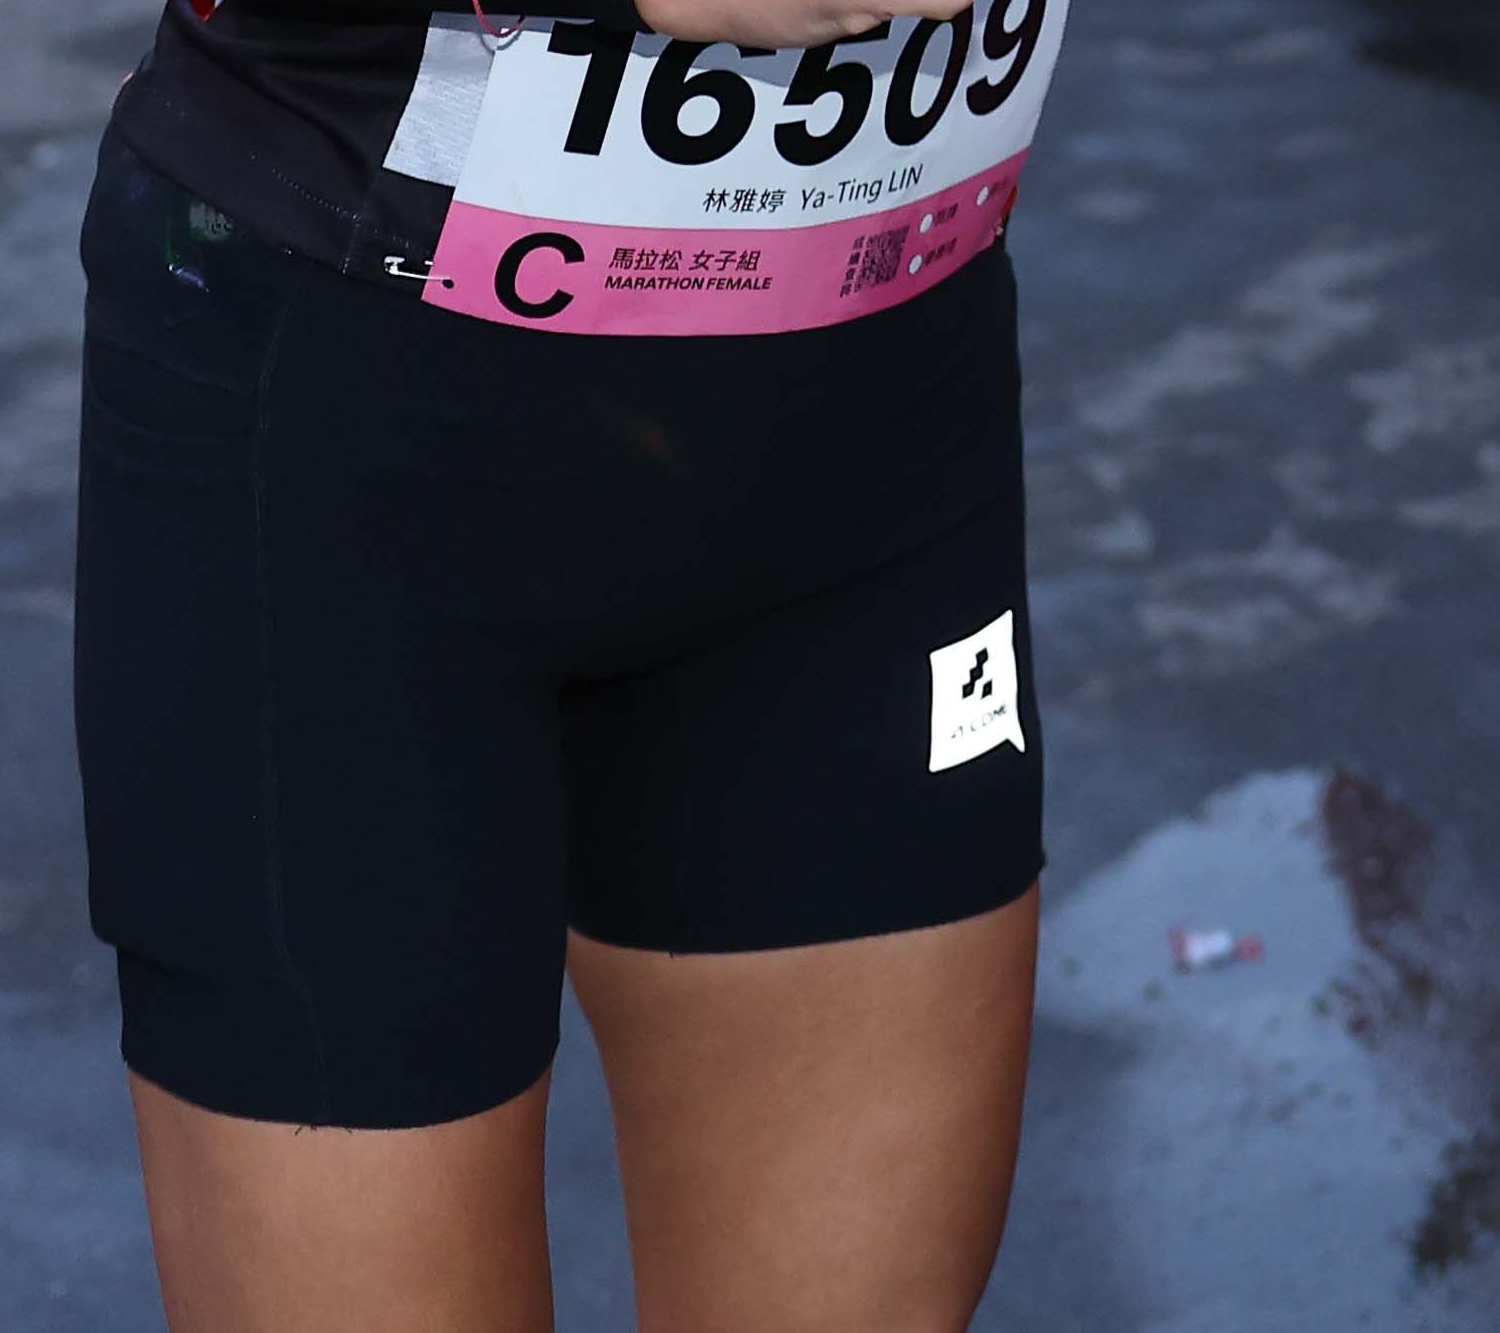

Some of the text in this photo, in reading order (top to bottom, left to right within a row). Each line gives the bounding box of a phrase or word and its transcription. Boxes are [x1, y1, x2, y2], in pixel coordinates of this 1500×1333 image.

[702, 163, 924, 214] 林雅婷 Ya-Ting LIN
[493, 231, 585, 318] C
[608, 247, 761, 272] 馬拉松 女子組
[603, 275, 773, 291] MARATHON FEMALE
